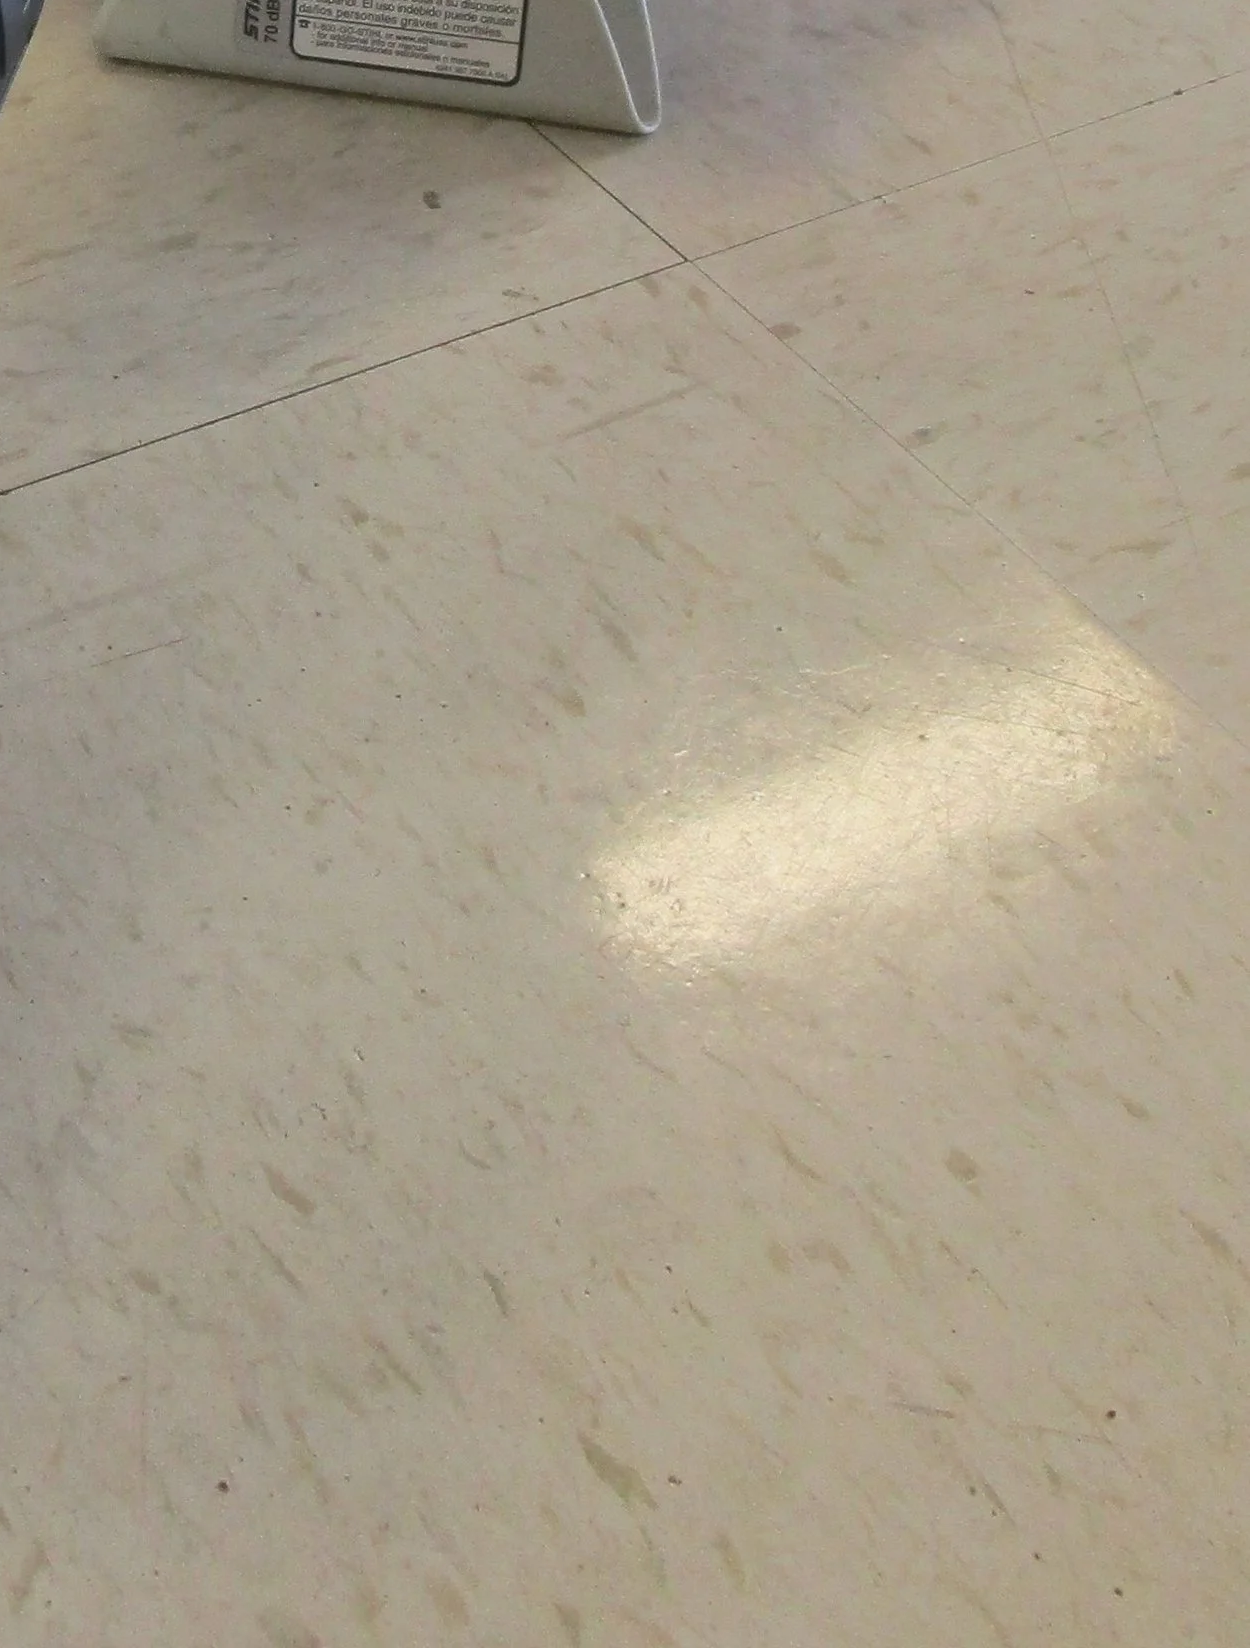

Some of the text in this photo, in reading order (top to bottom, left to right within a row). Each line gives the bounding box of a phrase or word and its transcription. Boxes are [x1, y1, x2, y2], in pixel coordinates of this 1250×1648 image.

[299, 3, 332, 15] daños
[336, 9, 397, 25] personales
[400, 16, 438, 29] graves
[442, 22, 450, 31] o
[376, 2, 395, 12] uso
[398, 4, 442, 18] indebido
[445, 10, 478, 23] puede
[480, 15, 517, 27] causar
[446, 0, 459, 8] su
[461, 0, 520, 15] disposición
[264, 25, 278, 43] 70
